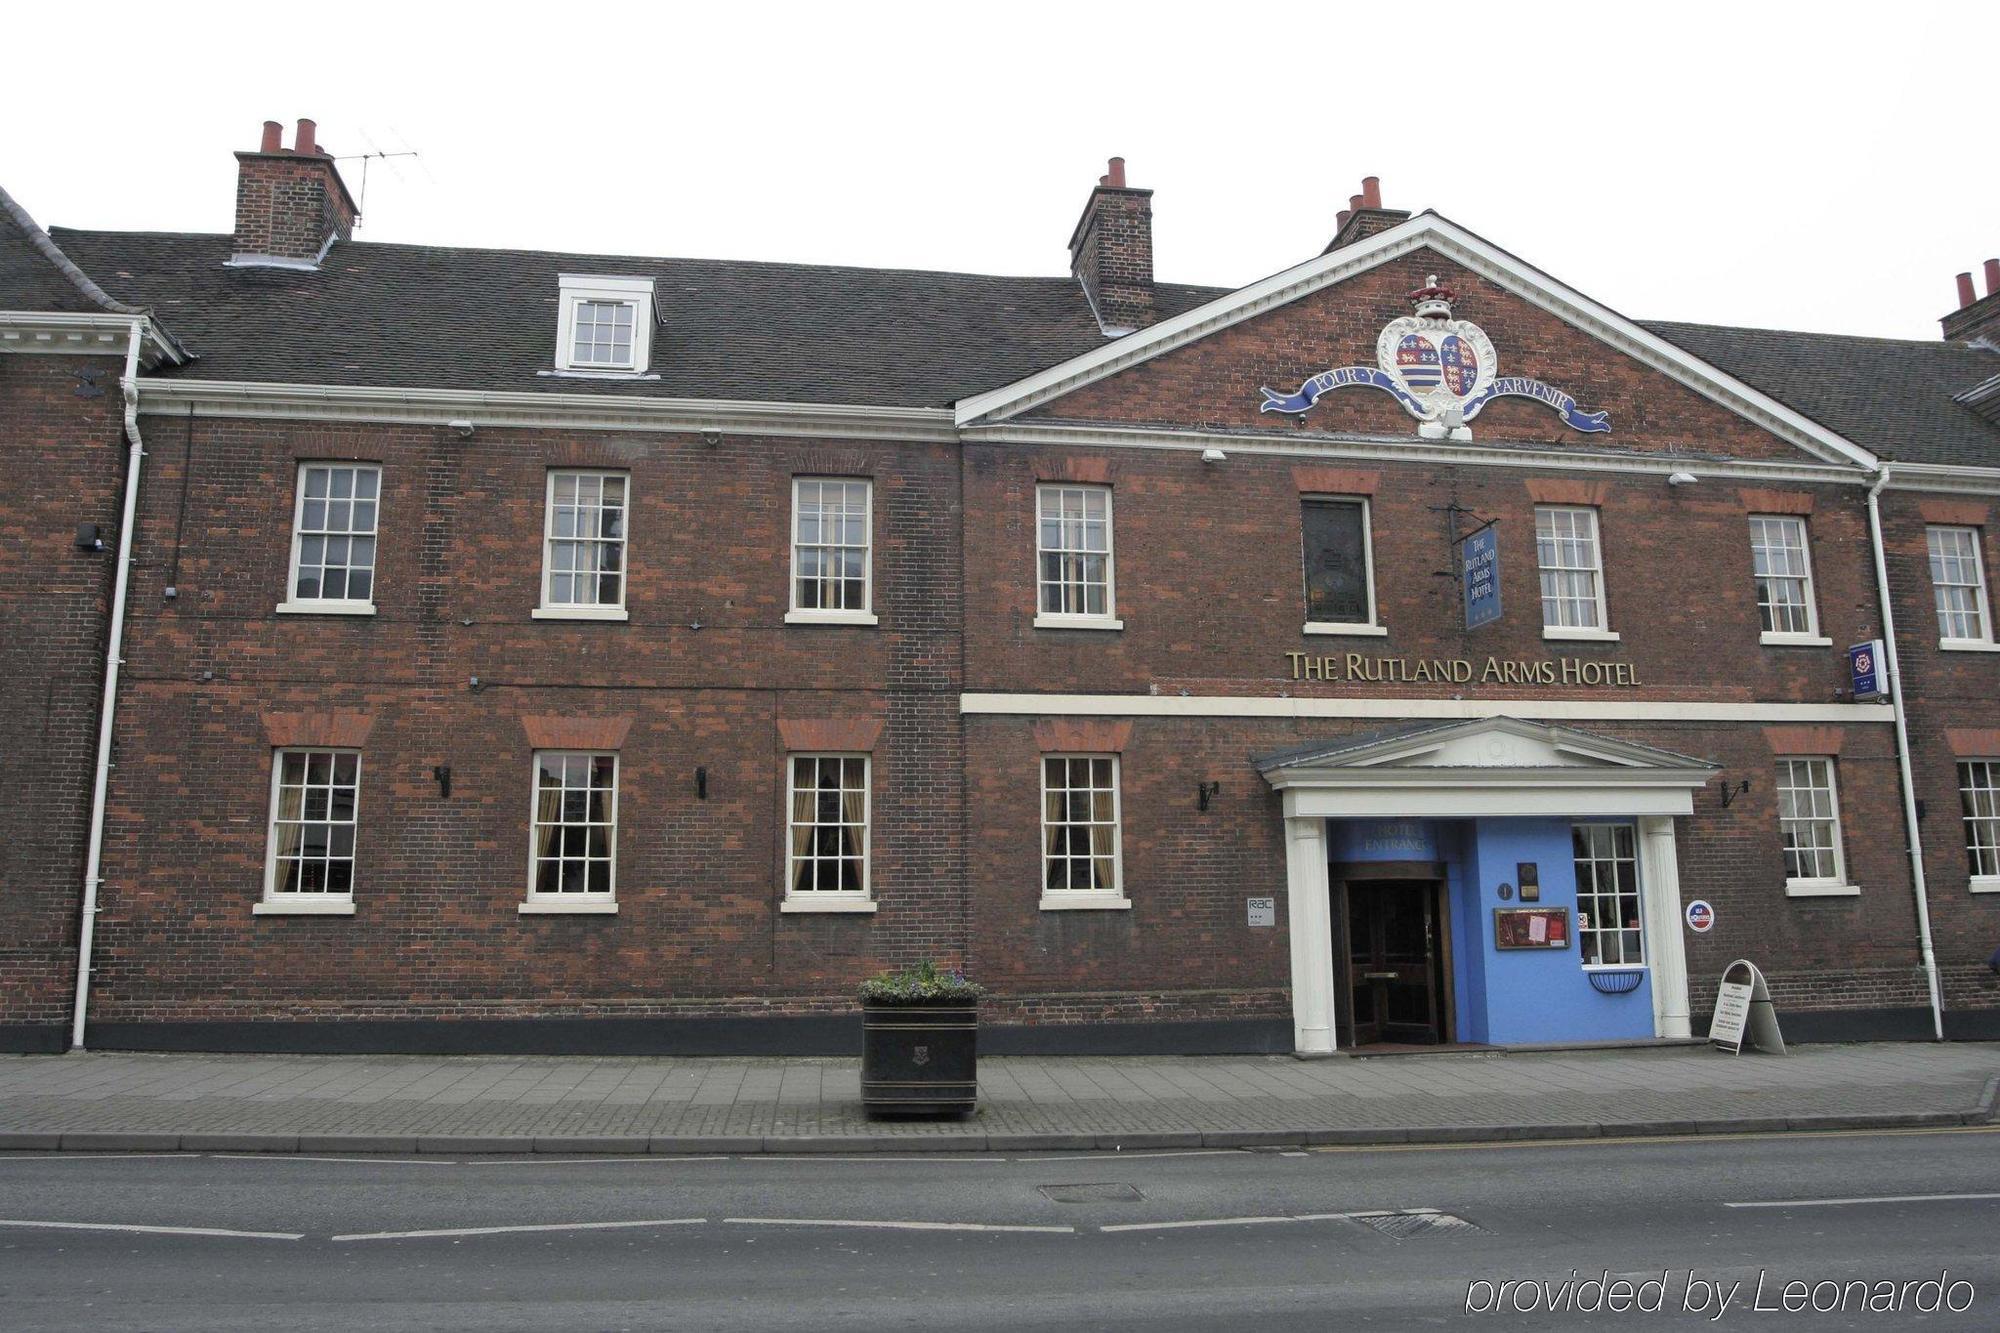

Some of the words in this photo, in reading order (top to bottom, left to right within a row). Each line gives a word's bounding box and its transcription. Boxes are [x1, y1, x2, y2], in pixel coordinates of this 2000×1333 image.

[1312, 368, 1360, 391] POUR
[1366, 368, 1377, 384] Y
[1493, 379, 1568, 409] PARVENIR
[1473, 538, 1485, 552] THE
[1465, 548, 1495, 572] RUTLAND
[1472, 567, 1491, 585] ARMS
[1471, 582, 1492, 600] HOTEL
[1285, 652, 1339, 680] THE
[1346, 653, 1472, 683] RUTLAND
[1480, 656, 1555, 684] ARMS
[1561, 658, 1642, 685] HOTEL
